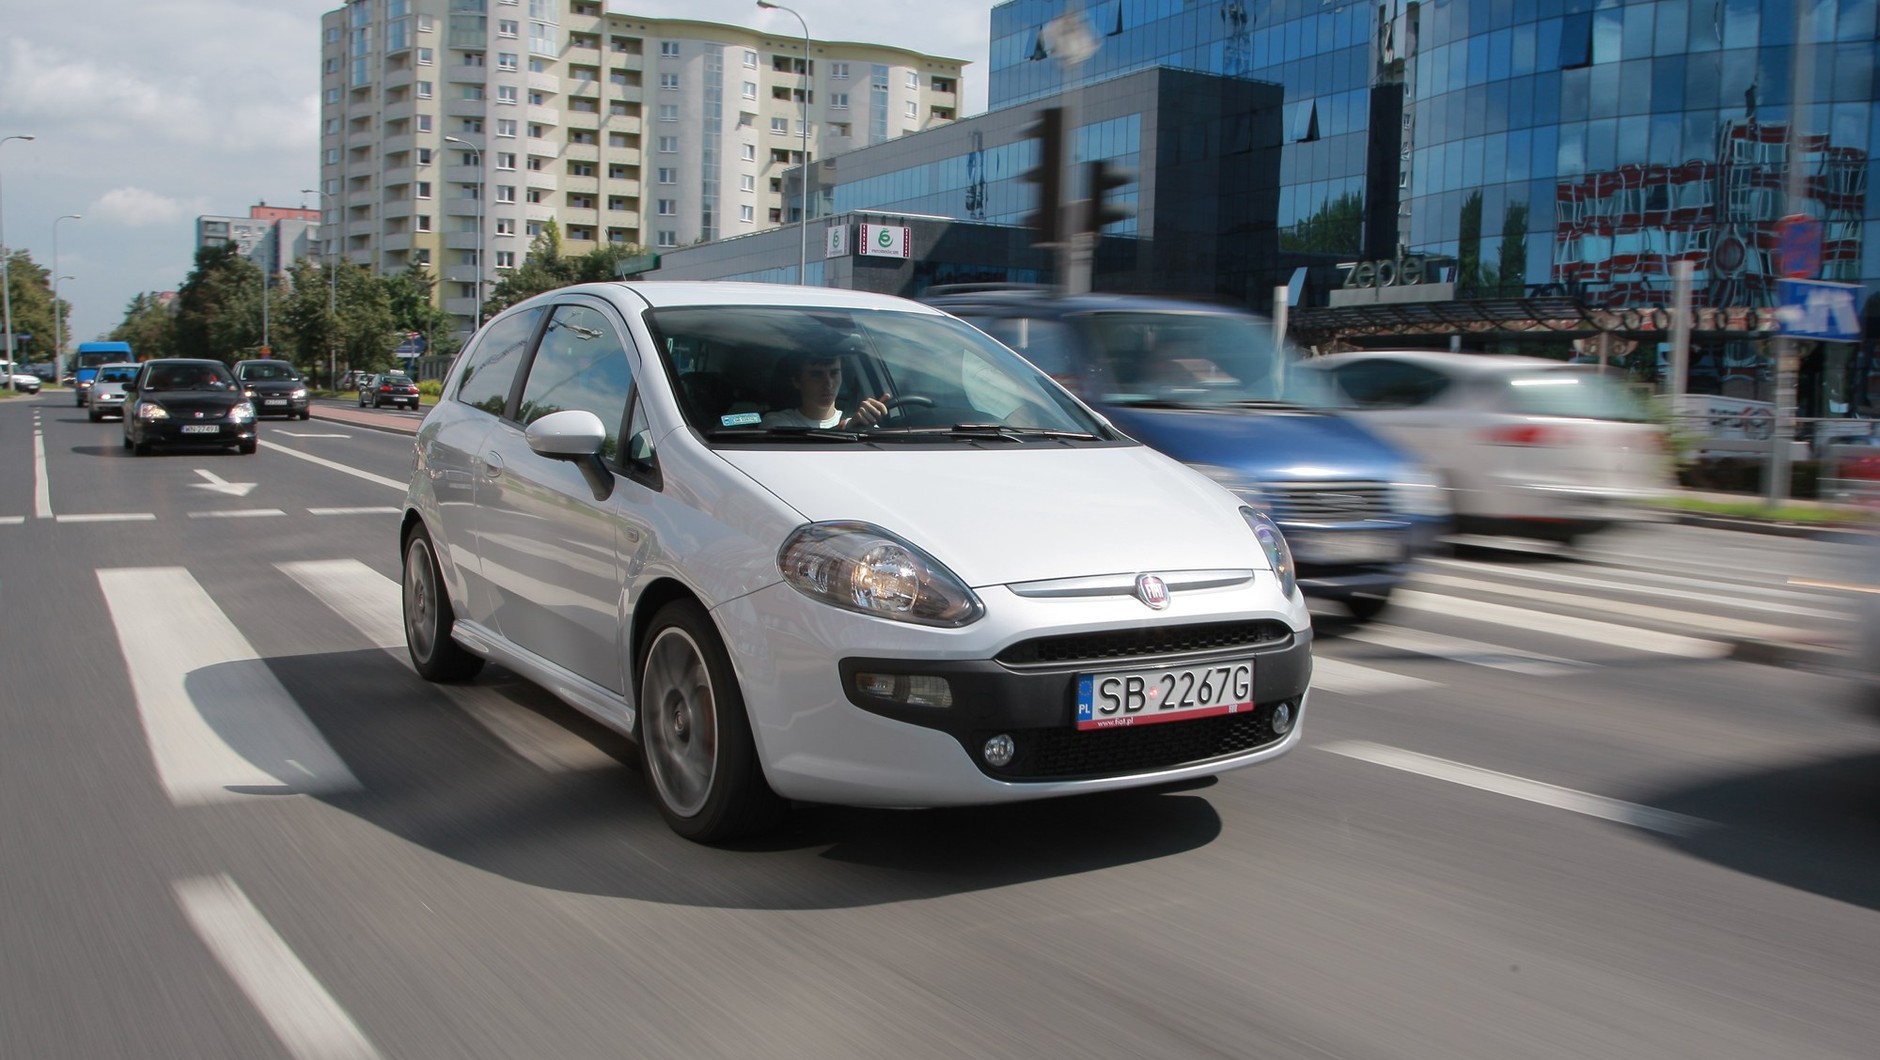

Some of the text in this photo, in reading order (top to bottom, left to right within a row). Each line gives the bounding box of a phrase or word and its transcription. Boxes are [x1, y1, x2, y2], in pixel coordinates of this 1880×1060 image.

[1099, 665, 1250, 716] SB 2267G
[1078, 703, 1091, 715] PL
[1097, 717, 1134, 728] www.fiat.pl
